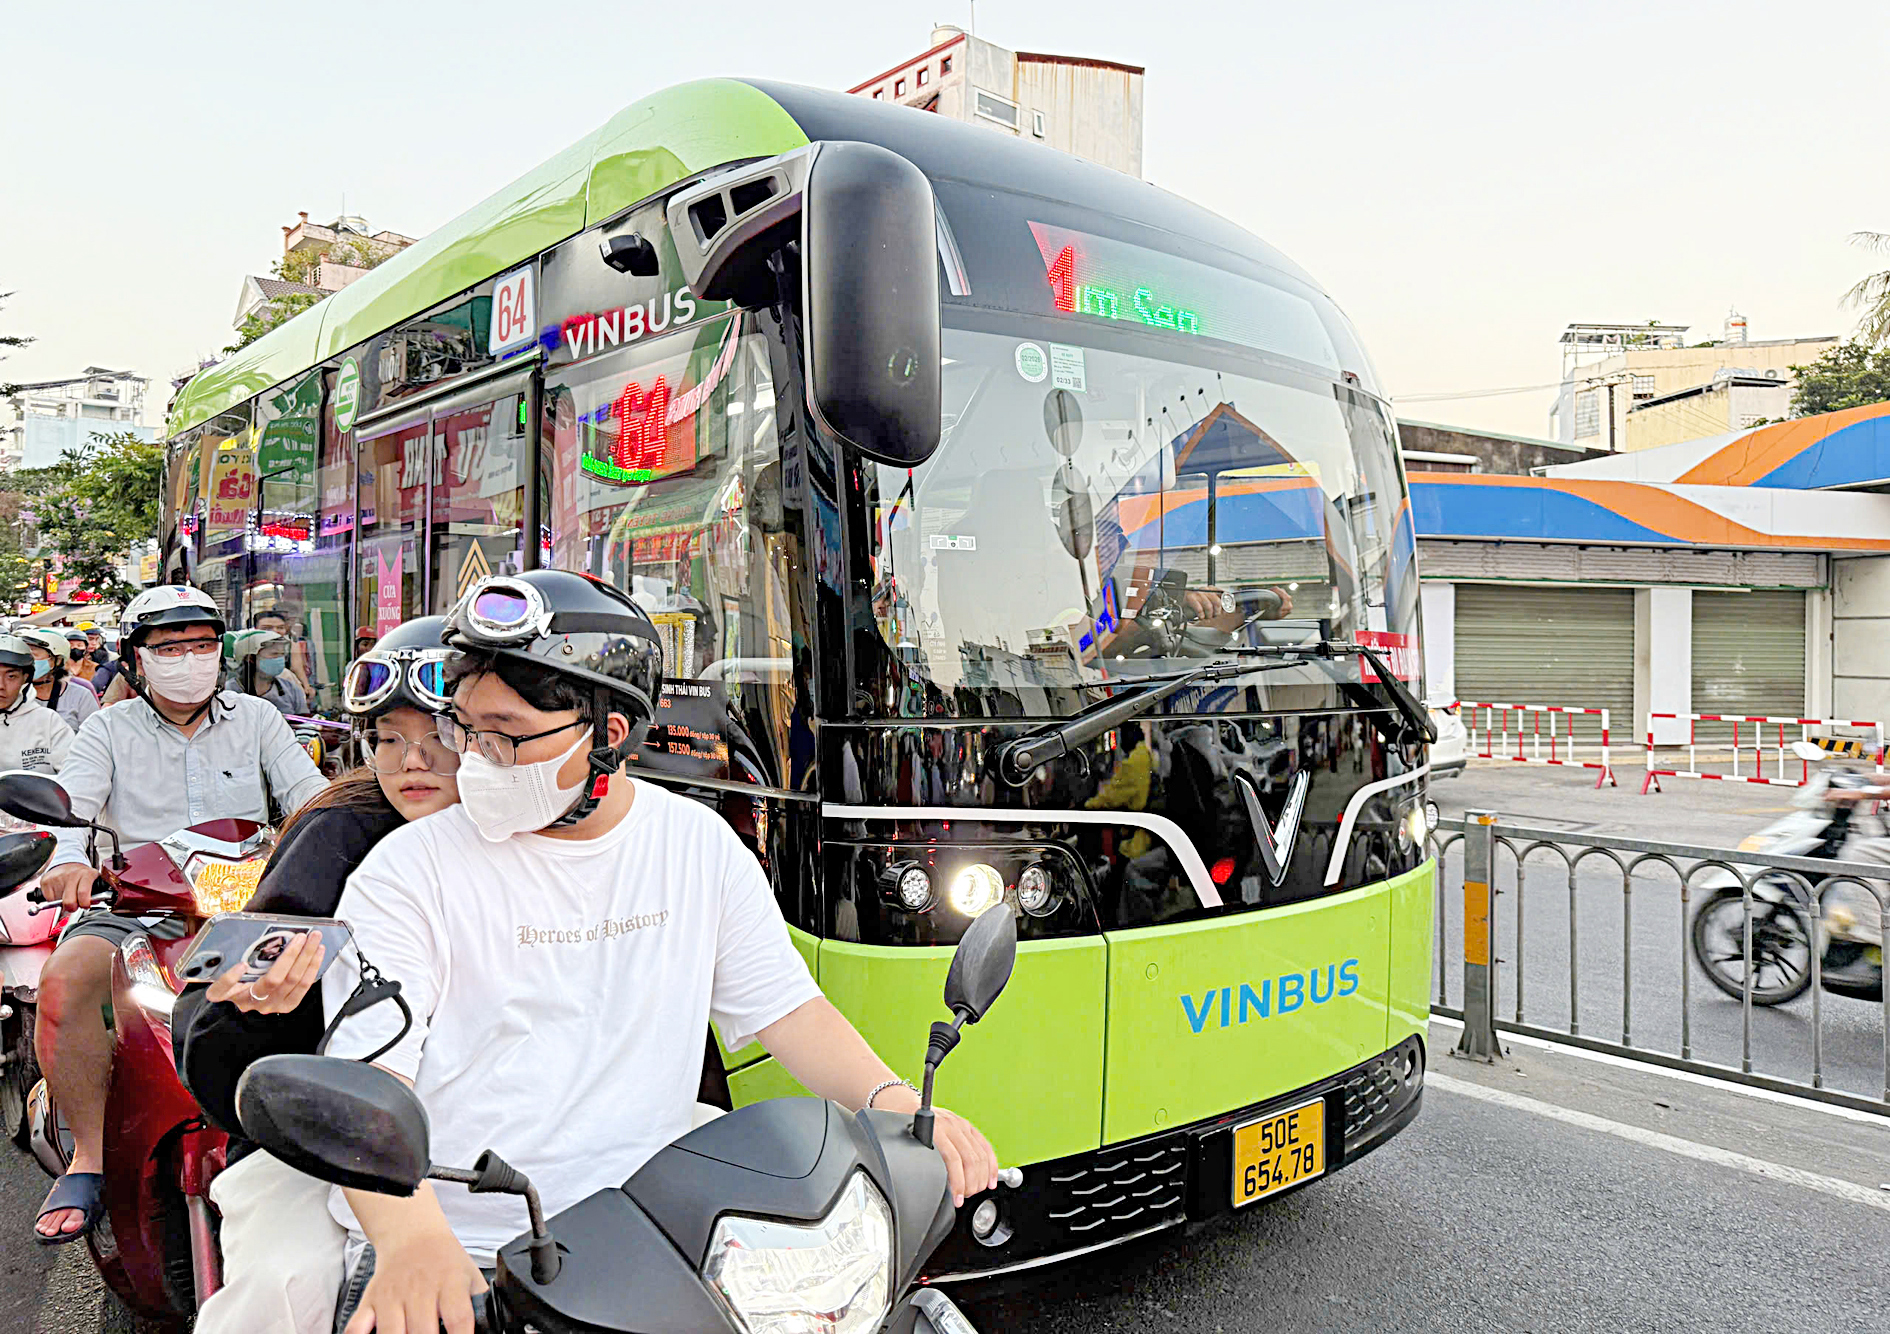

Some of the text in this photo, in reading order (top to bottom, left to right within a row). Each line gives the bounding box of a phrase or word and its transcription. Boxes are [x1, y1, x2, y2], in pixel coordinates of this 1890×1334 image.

[498, 277, 527, 342] 64
[566, 286, 696, 360] VINBUS
[622, 375, 665, 470] 64
[383, 581, 396, 599] CỬA
[378, 602, 400, 620] XUỐNG
[662, 682, 711, 697] SINH THÁI VIN BUS
[667, 724, 690, 738] 135.000
[668, 742, 690, 755] 157.500
[517, 909, 670, 948] Heroes of History
[1180, 958, 1359, 1034] VINBUS
[1261, 1112, 1299, 1155] 50E
[1243, 1142, 1315, 1197] 654.78
